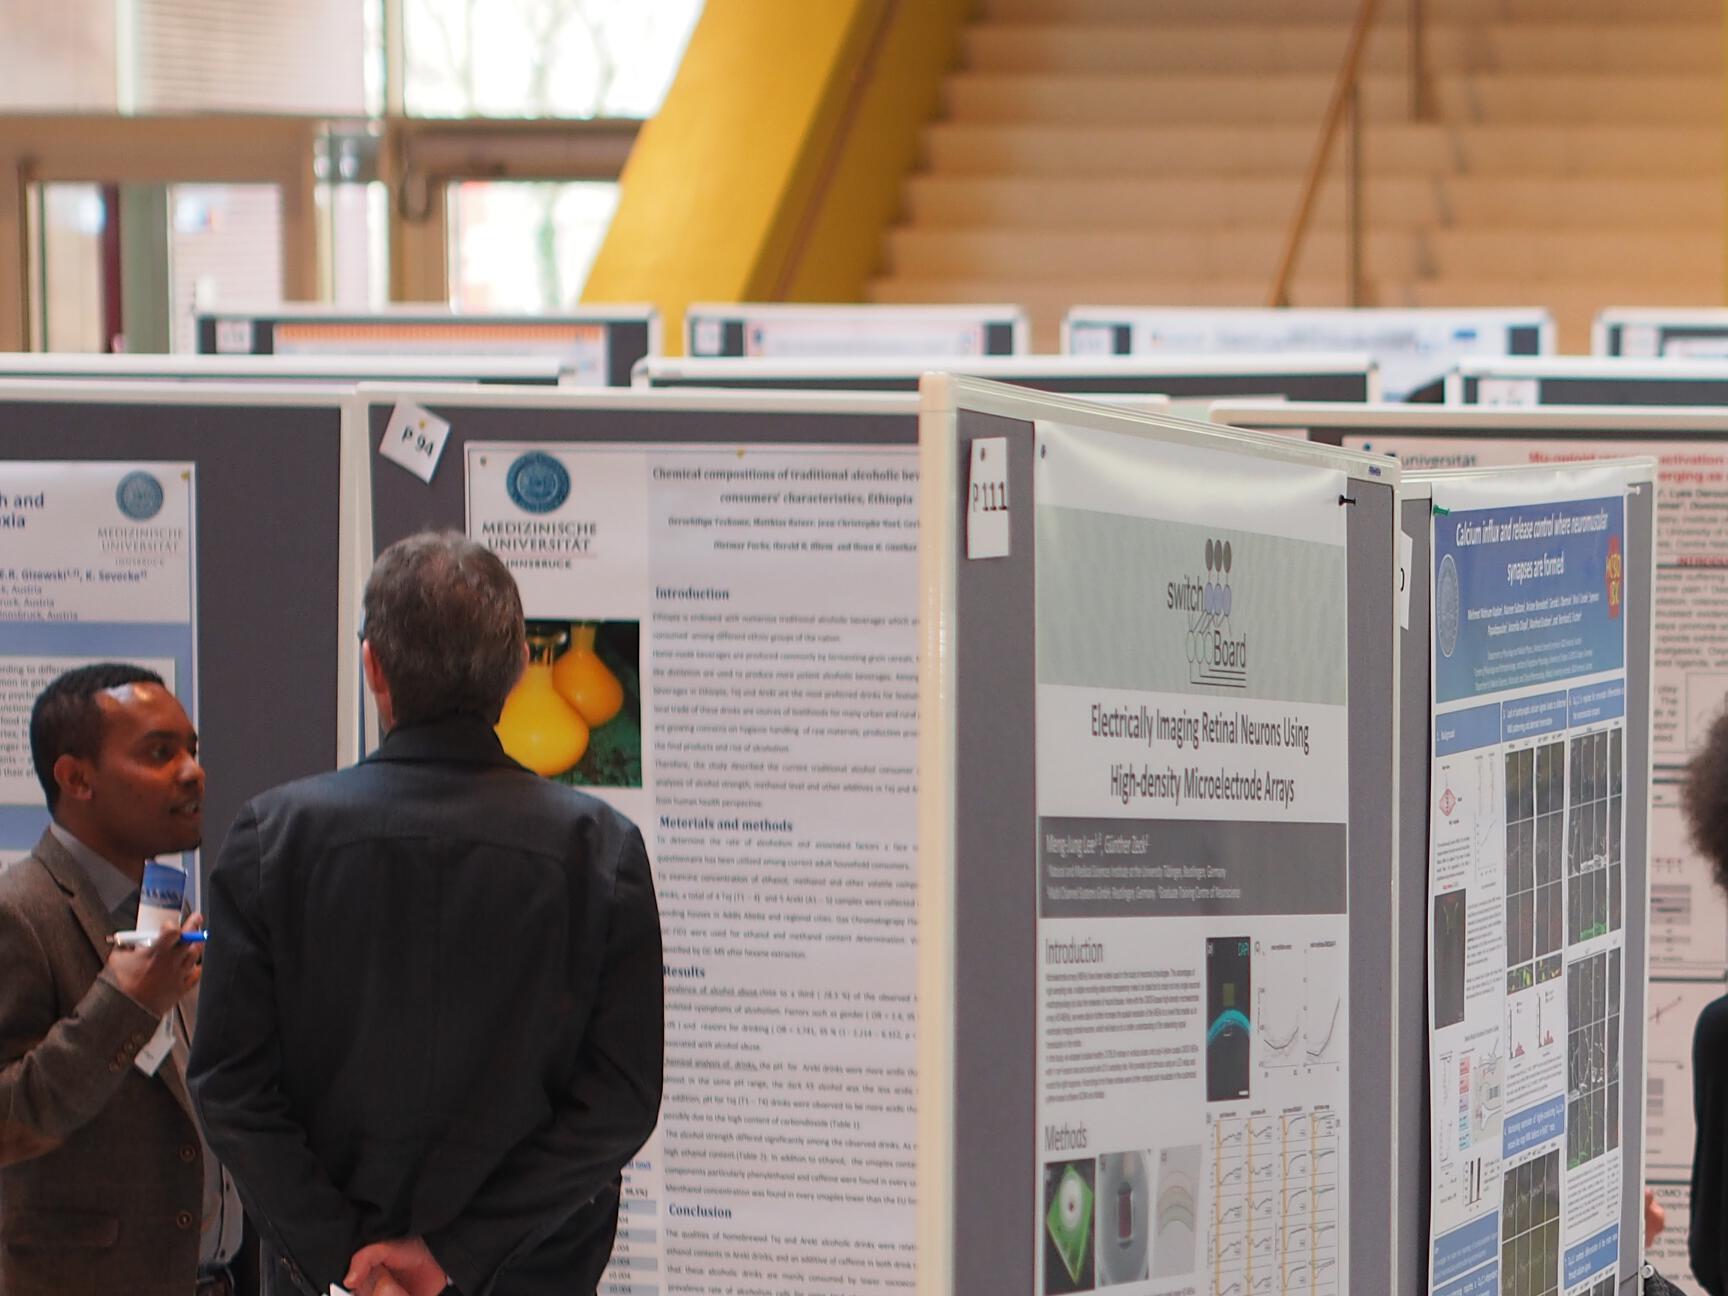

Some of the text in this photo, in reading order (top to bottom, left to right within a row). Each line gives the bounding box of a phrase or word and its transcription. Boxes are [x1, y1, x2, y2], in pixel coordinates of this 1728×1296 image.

[401, 426, 434, 457] P 94
[1401, 453, 1477, 468] universität
[653, 467, 701, 481] Chemical
[704, 468, 775, 485] compositions
[777, 468, 789, 481] of
[791, 469, 848, 482] traditional
[851, 469, 899, 482] alcoholic
[1658, 472, 1708, 483] erging
[1709, 473, 1724, 481] as
[14, 491, 45, 509] and
[783, 492, 865, 507] characteristics,
[868, 493, 913, 507] Ethiopia
[981, 482, 1008, 511] 111
[97, 527, 184, 539] MEDIZINISCHE
[481, 522, 597, 535] MEDIZINISCHE
[1456, 509, 1608, 547] Calcium influx and release control where neuromuscular
[487, 537, 590, 551] UNIVERSITÄT
[506, 559, 571, 569] INNSBRUCK
[1507, 552, 1564, 586] synapses are formed
[11, 585, 42, 595] Austria
[655, 586, 730, 601] Introduction
[1166, 574, 1204, 613] switch
[24, 598, 55, 607] Austria
[46, 610, 78, 621] Austria
[1213, 630, 1247, 669] Board
[1091, 703, 1310, 756] Electrically Imaging Retinal Neurons Using
[1110, 763, 1295, 809] High-density Microelectrode Arrays
[717, 817, 738, 830] and
[742, 819, 793, 832] methods
[1045, 936, 1103, 965] Introduction
[663, 965, 705, 978] Results
[1044, 1120, 1087, 1151] Methods
[669, 1203, 732, 1219] Conclusion
